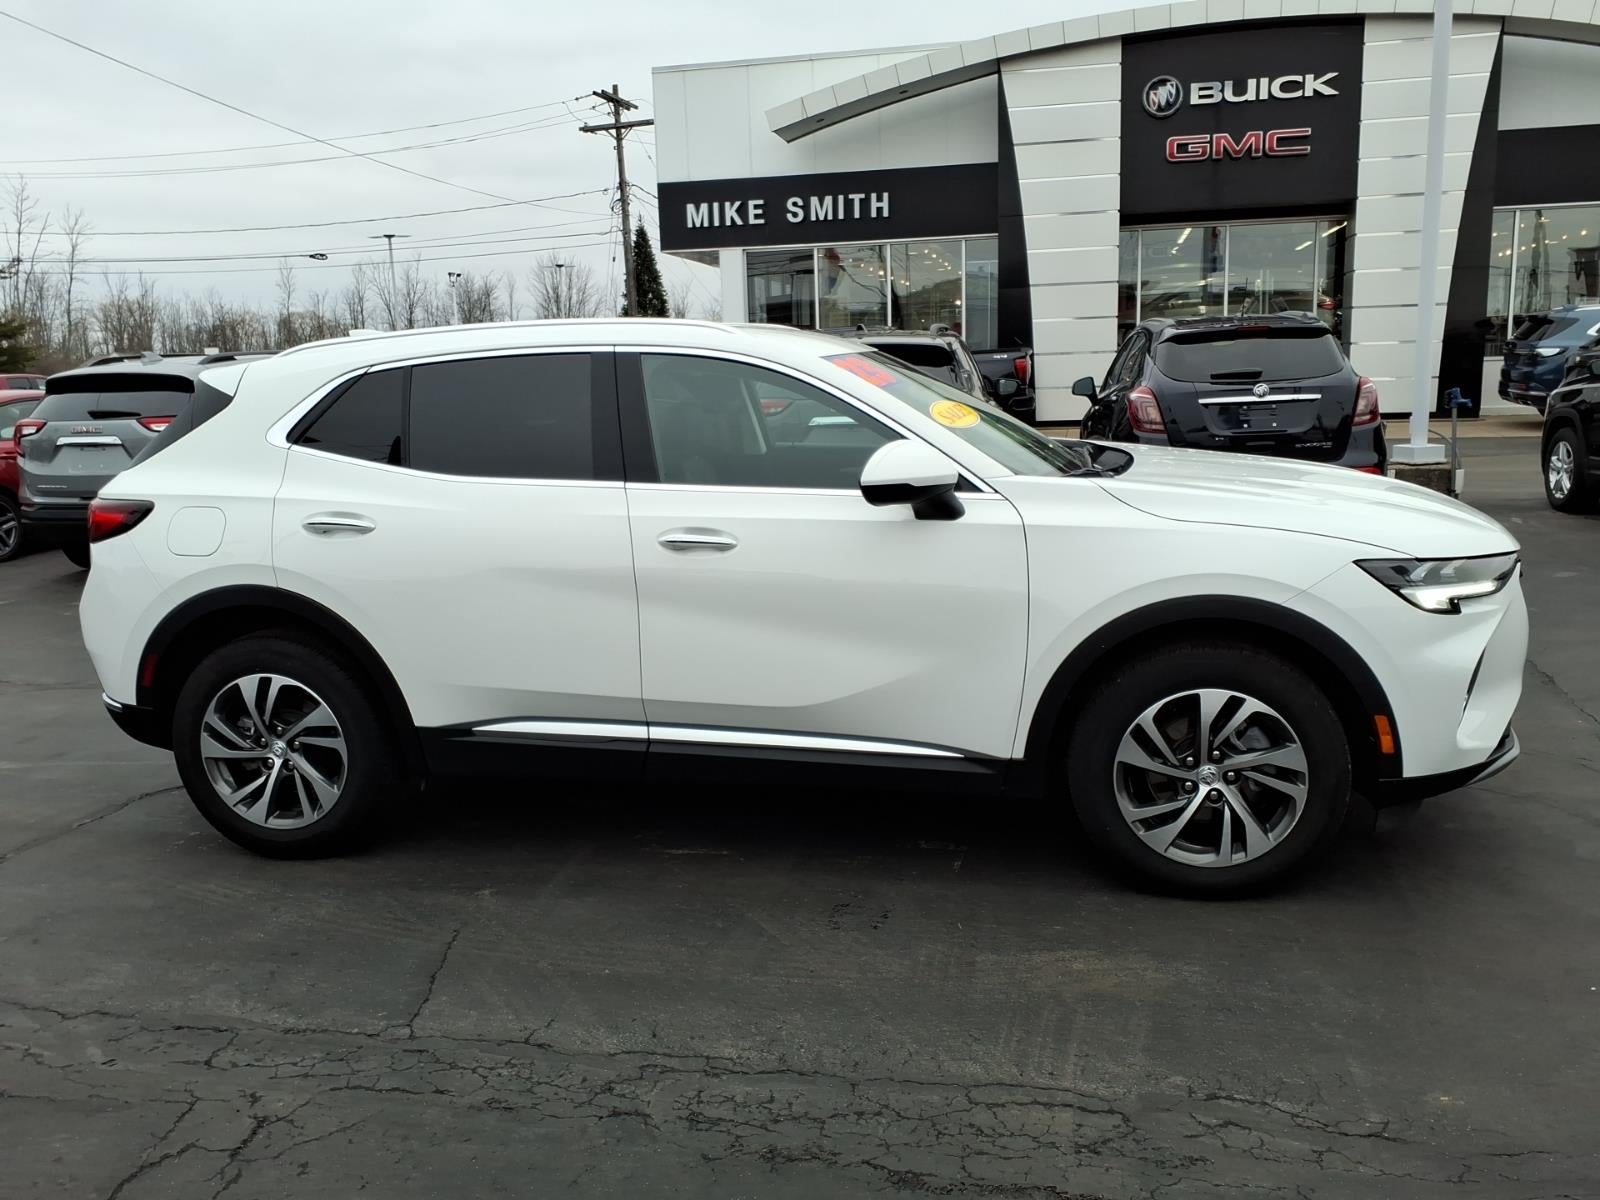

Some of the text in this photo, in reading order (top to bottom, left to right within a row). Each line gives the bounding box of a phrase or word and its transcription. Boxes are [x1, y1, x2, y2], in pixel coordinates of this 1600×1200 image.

[1190, 72, 1339, 105] BUICK
[1166, 127, 1312, 161] GMC
[686, 192, 890, 228] MIKE SMITH
